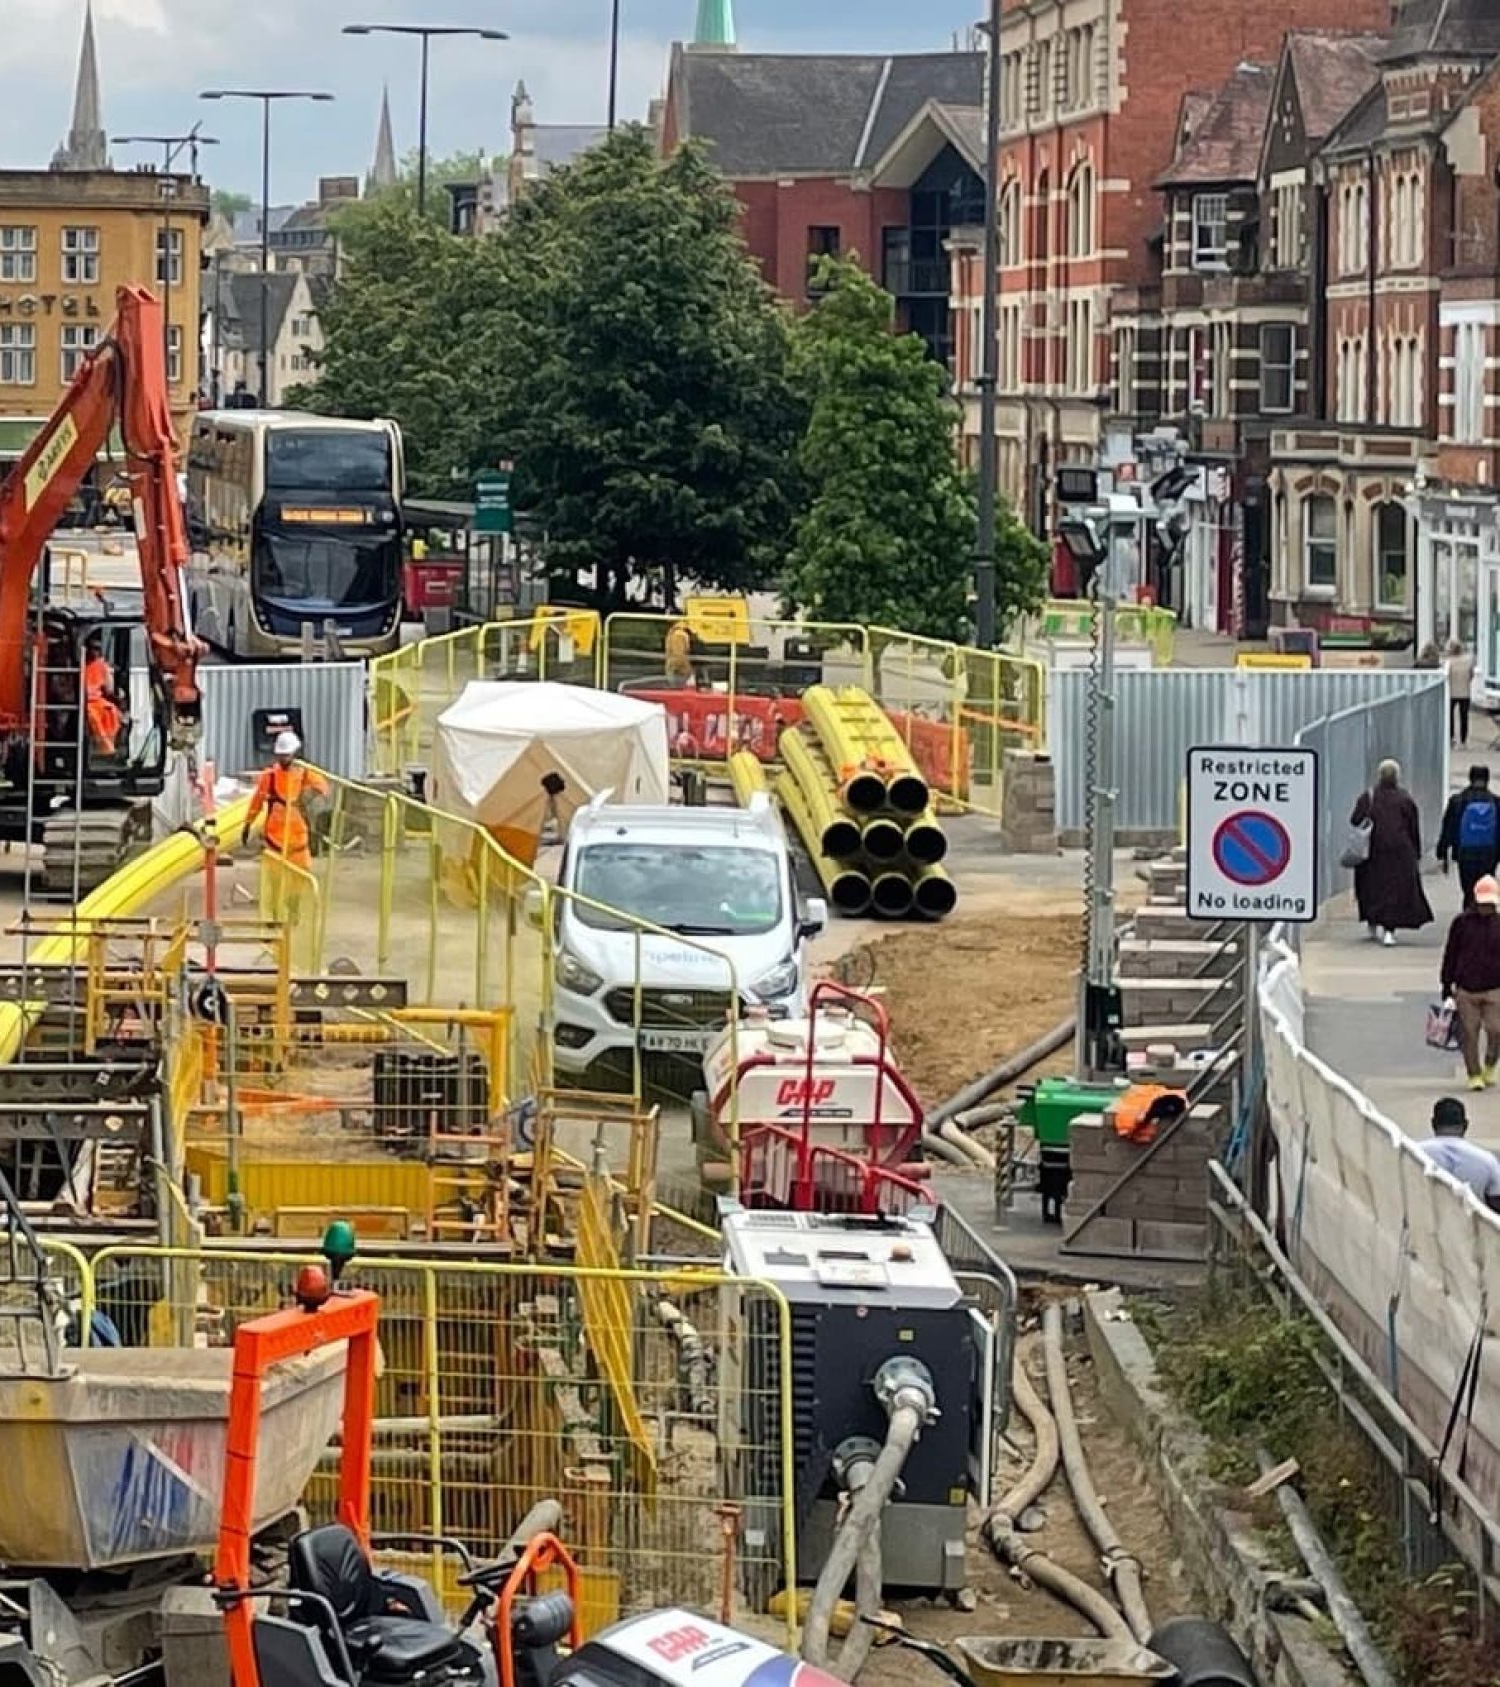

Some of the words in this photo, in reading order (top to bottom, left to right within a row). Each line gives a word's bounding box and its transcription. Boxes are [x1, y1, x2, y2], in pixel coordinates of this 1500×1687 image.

[1201, 758, 1305, 776] Restricted
[1213, 781, 1290, 802] ZONE
[1198, 892, 1226, 909] No
[1233, 893, 1306, 914] loading
